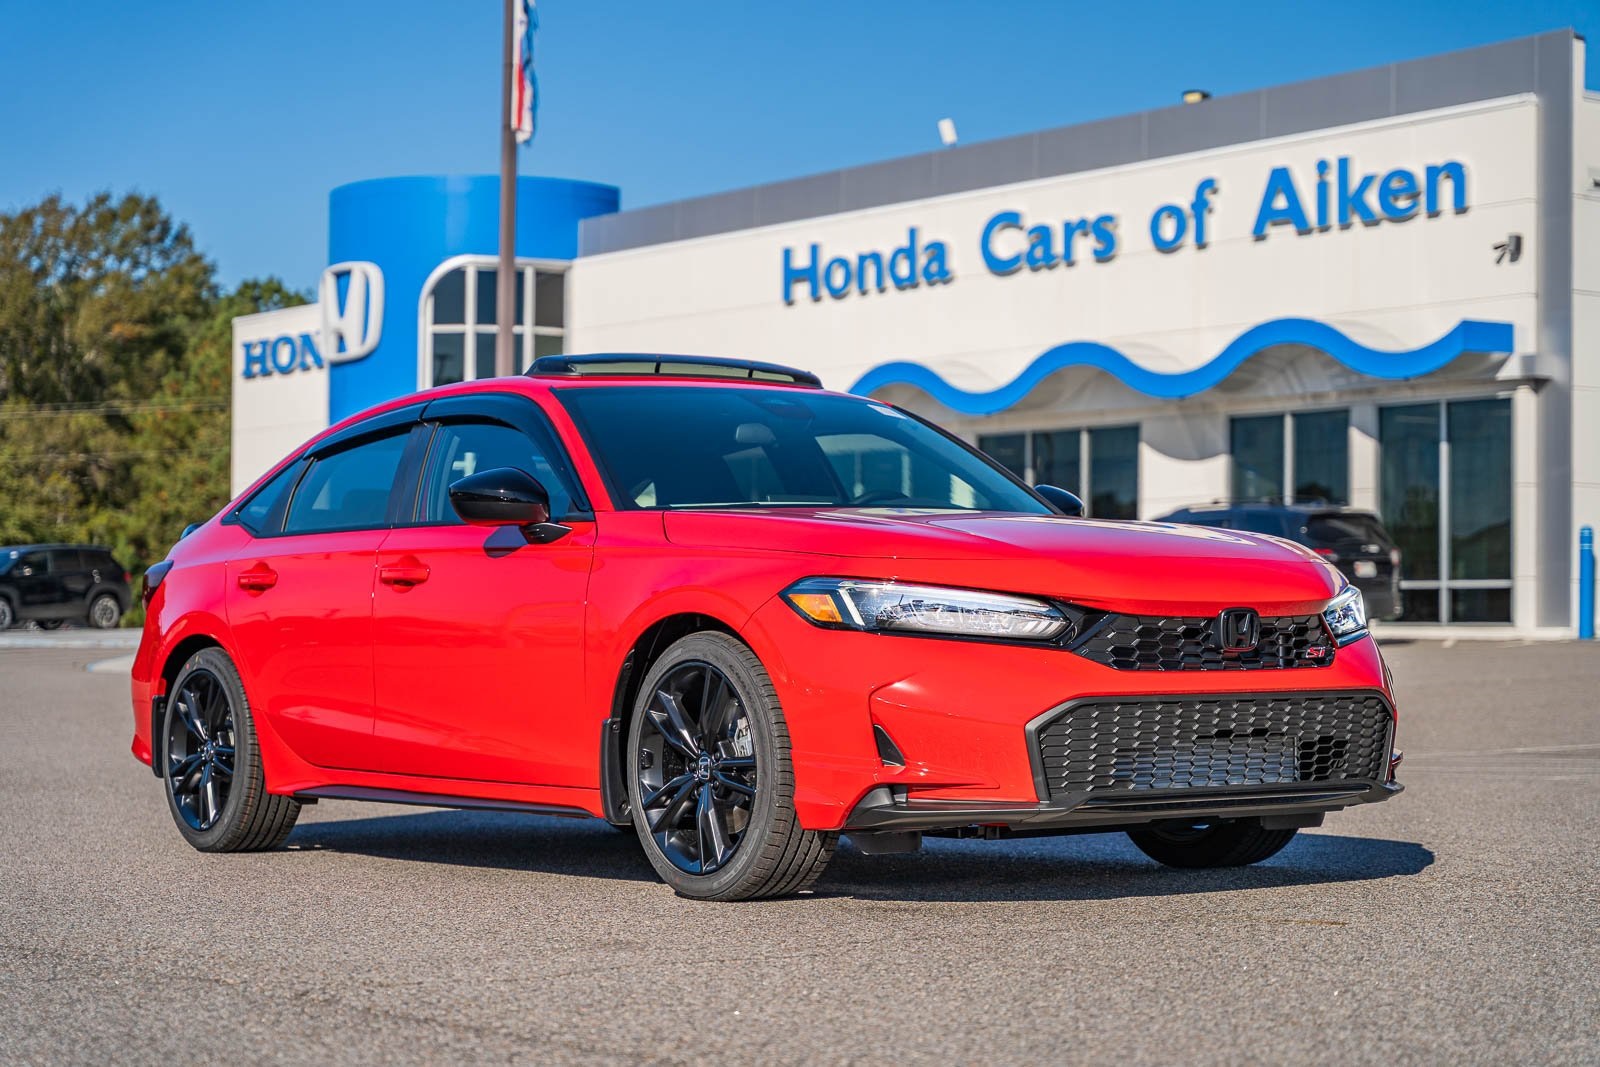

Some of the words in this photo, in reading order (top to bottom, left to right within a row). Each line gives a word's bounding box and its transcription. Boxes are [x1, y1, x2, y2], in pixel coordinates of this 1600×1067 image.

[783, 227, 953, 306] Honda
[981, 210, 1118, 277] Cars
[1150, 178, 1218, 253] of
[1252, 155, 1469, 242] Aiken
